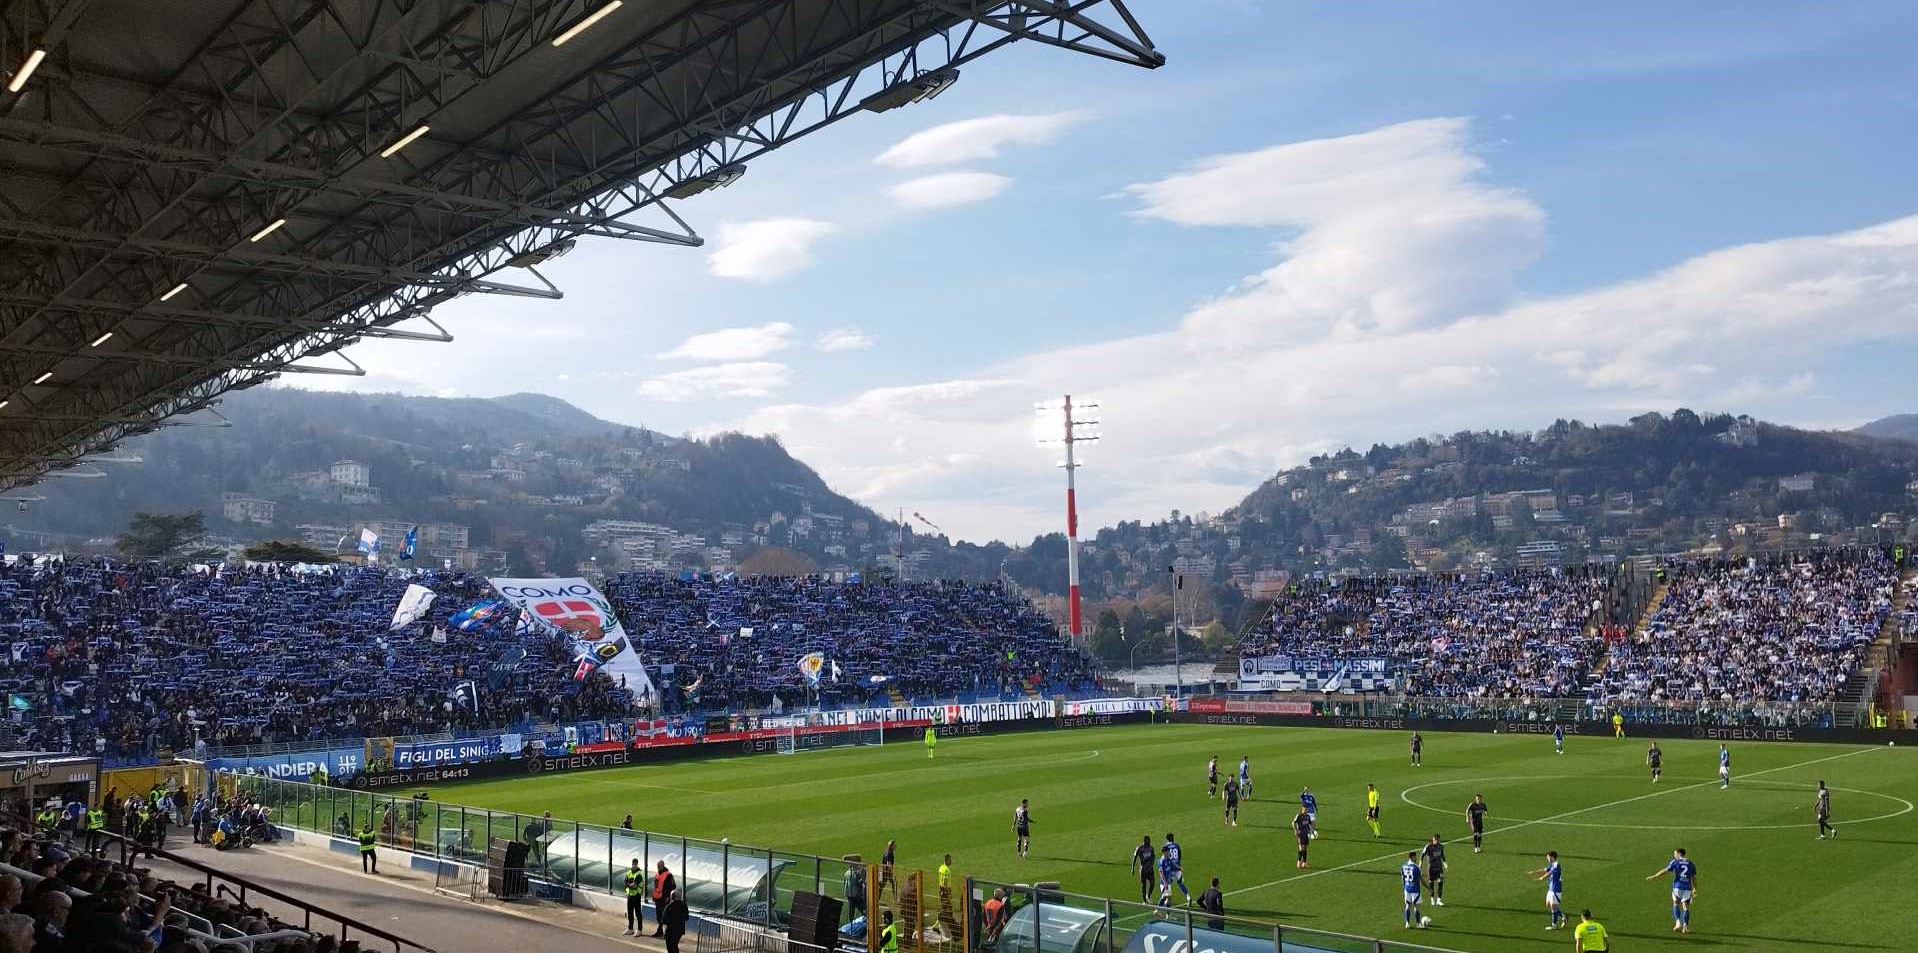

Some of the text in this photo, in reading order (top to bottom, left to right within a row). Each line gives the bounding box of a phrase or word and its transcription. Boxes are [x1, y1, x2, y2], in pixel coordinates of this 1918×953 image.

[502, 585, 591, 598] COMO
[1295, 659, 1322, 671] PESI
[1334, 659, 1385, 672] MASSIMI
[1261, 680, 1280, 689] COMO
[856, 708, 892, 724] NOME
[1063, 715, 1113, 727] smetx.net
[1208, 713, 1257, 724] smetx.net
[932, 722, 982, 736] metx.net
[1346, 718, 1404, 729] smetx.net
[1707, 727, 1794, 740] smetx.net
[400, 751, 432, 763] FIGLI
[435, 748, 457, 760] DEL
[545, 751, 630, 771] smetx.net
[369, 768, 469, 787] smetx.net 64:13
[1680, 864, 1689, 878] 2
